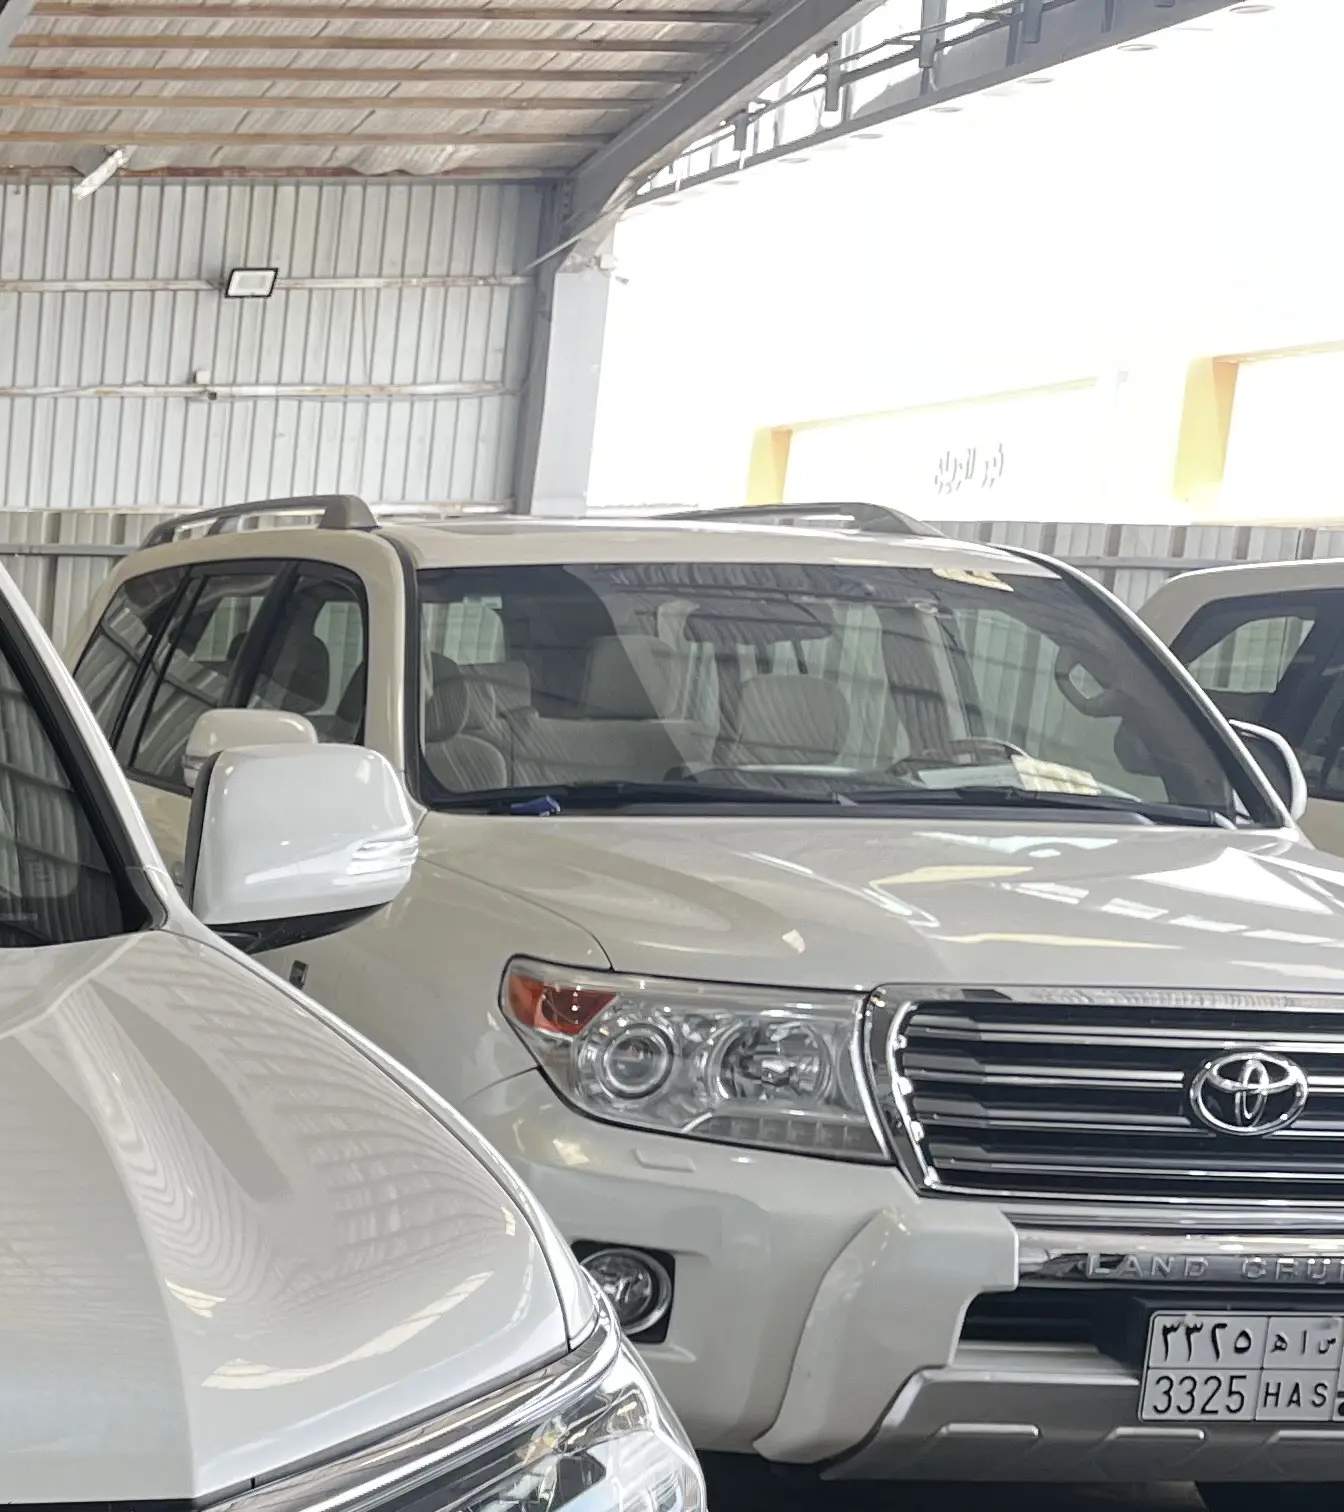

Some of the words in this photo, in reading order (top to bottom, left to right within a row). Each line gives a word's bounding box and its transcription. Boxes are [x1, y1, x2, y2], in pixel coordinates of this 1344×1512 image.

[1086, 1252, 1209, 1280] LAND
[1153, 1375, 1248, 1416] 3325
[1262, 1382, 1329, 1408] HAS
